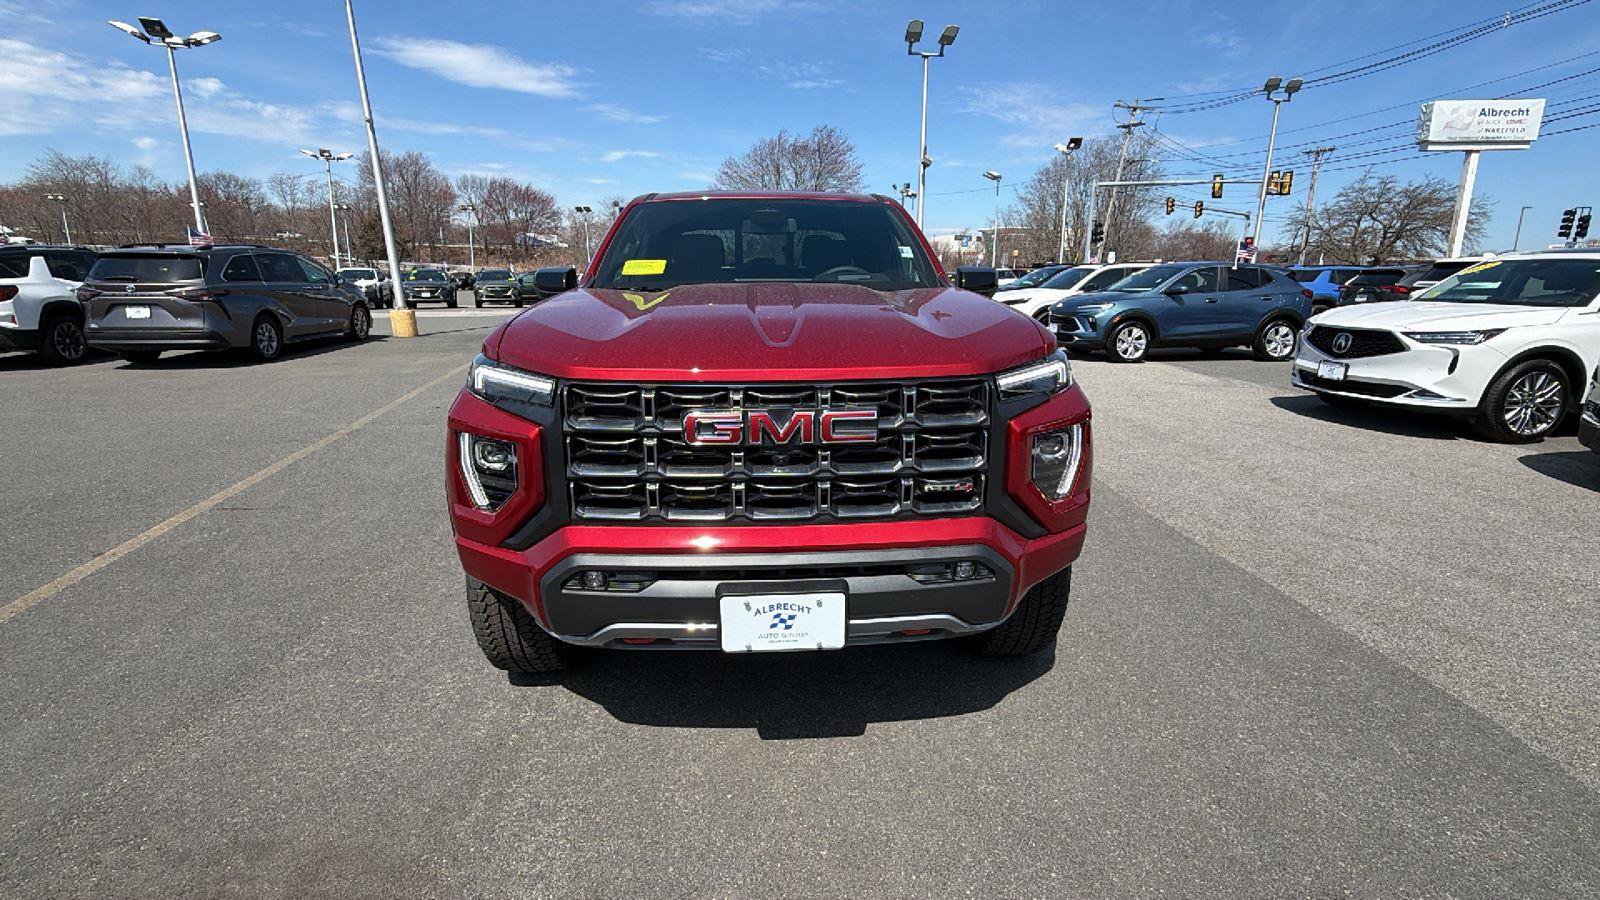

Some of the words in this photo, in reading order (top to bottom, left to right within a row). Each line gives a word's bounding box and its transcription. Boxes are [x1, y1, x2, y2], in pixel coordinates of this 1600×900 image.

[1478, 107, 1531, 117] Albrecht
[684, 410, 878, 445] GMC
[753, 602, 813, 618] ALBRECHT
